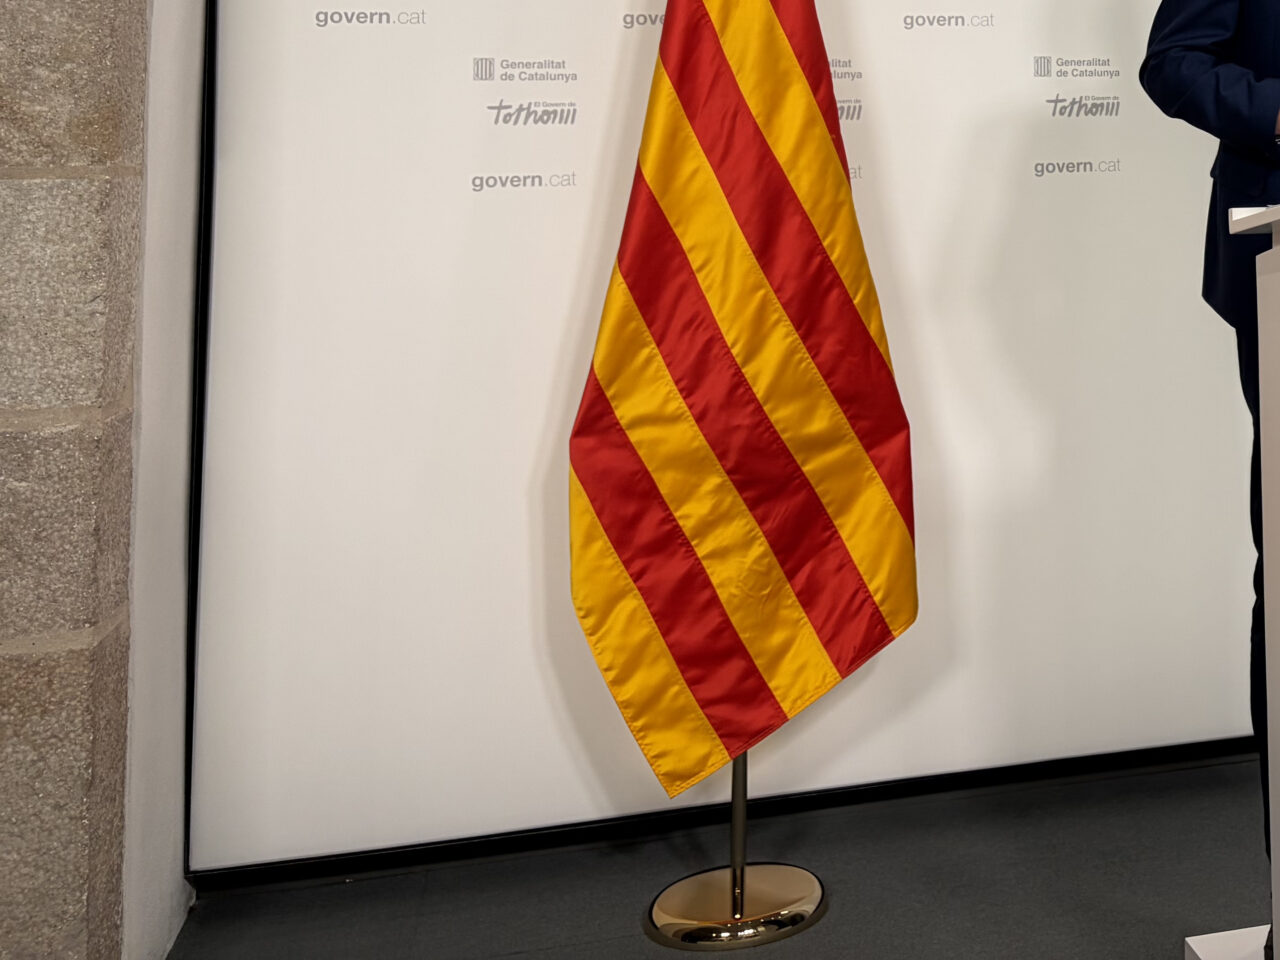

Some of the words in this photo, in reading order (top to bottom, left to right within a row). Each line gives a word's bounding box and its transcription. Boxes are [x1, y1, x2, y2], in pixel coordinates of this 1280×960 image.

[315, 9, 427, 28] govern.cat
[903, 13, 995, 30] govern.cat
[500, 59, 566, 69] Generalitat
[830, 59, 852, 68] litat
[1056, 58, 1110, 67] Generalitat
[500, 71, 515, 81] de
[518, 71, 578, 83] Catalunya
[833, 70, 863, 81] lunya
[1056, 68, 1069, 78] de
[1071, 68, 1120, 79] Catalunya
[1034, 158, 1121, 177] govern.cat
[471, 170, 577, 192] govern.cat
